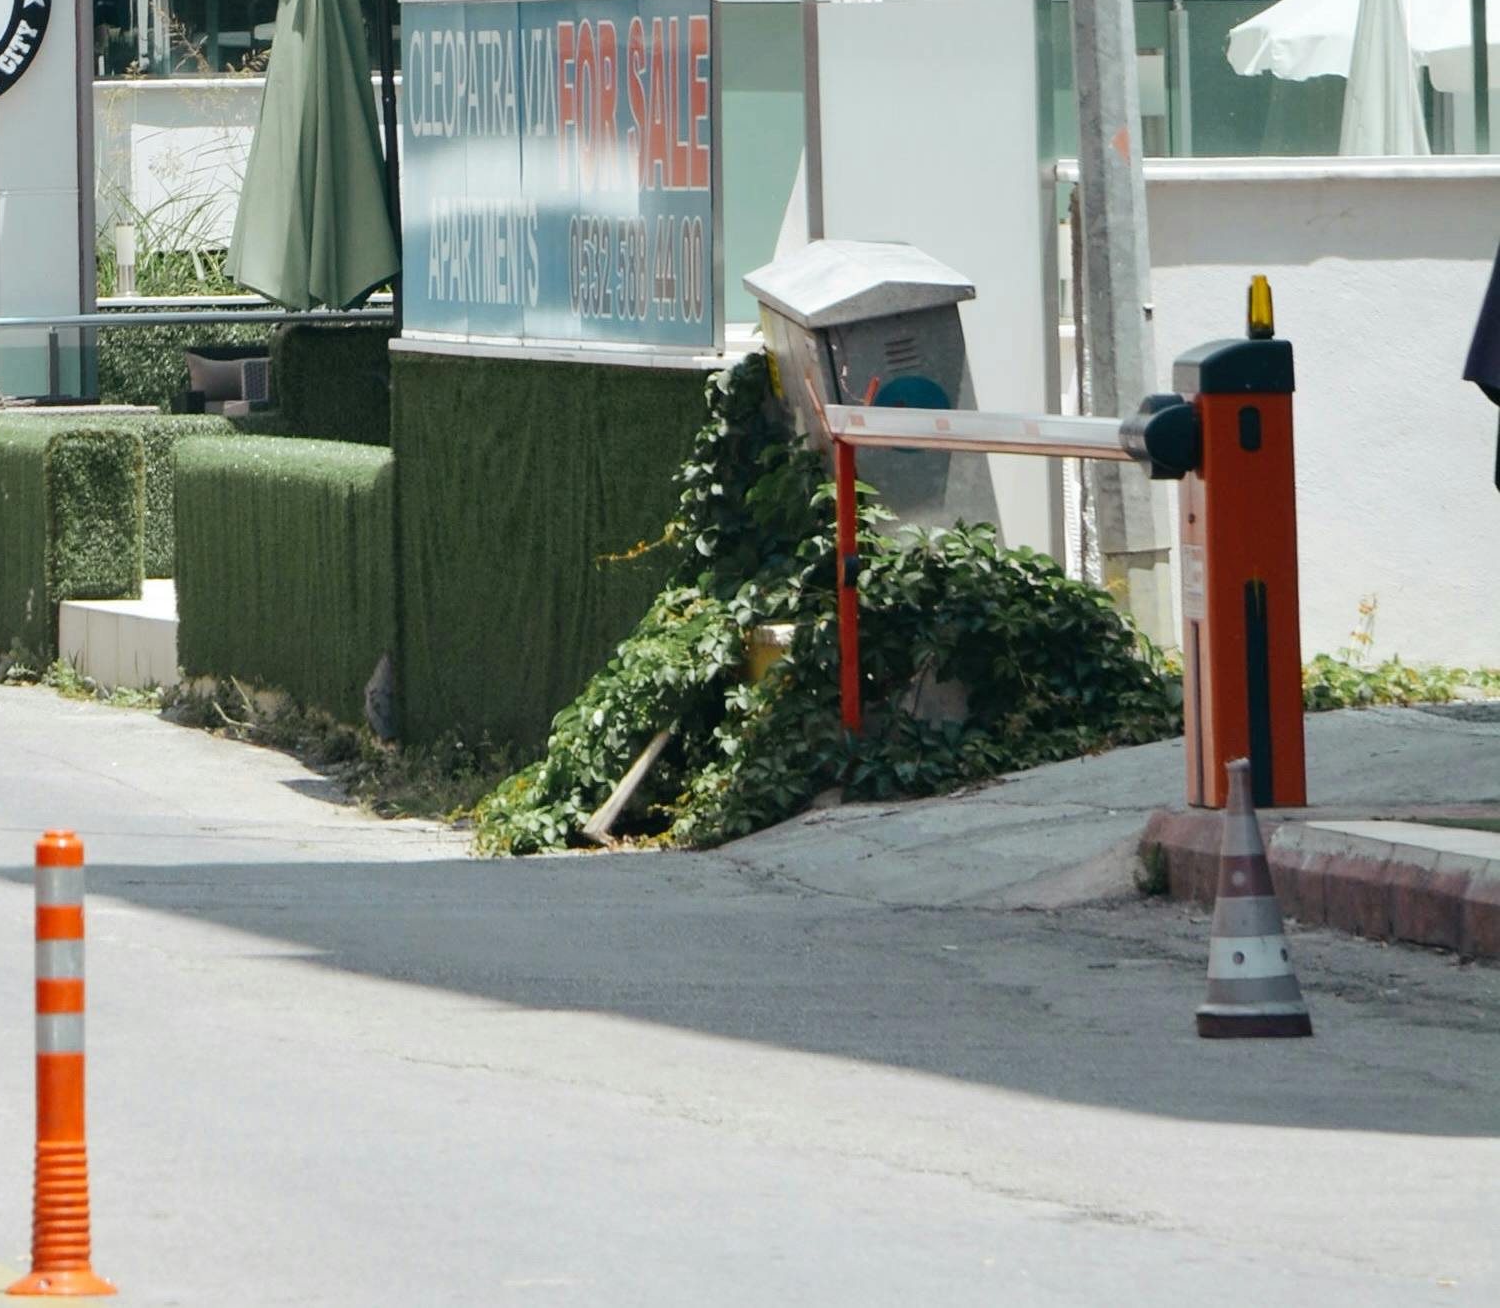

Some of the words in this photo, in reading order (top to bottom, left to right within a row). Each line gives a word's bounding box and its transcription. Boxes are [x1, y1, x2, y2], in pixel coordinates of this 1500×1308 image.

[409, 29, 518, 138] CLEOPATRA
[557, 18, 618, 192] FOR
[627, 15, 709, 191] SALE
[428, 197, 539, 307] APARTMENTS
[569, 214, 612, 319] 0532
[616, 216, 647, 321] 588
[652, 215, 677, 322] 44
[680, 215, 704, 323] 00
